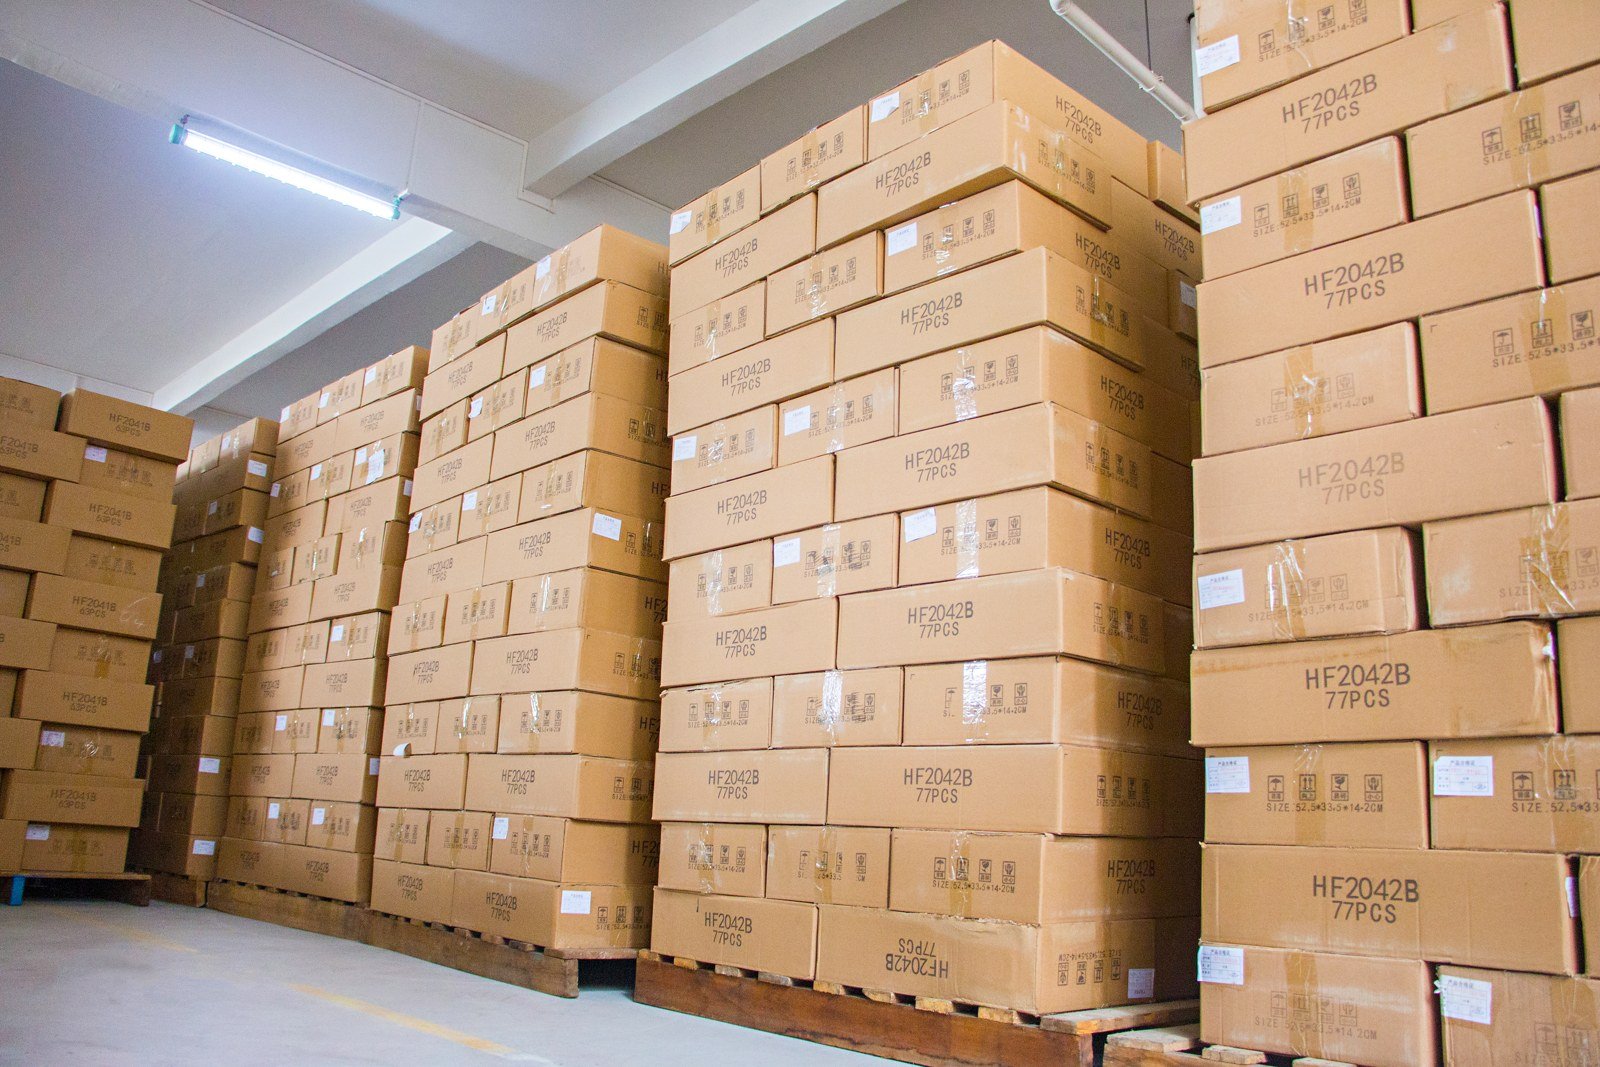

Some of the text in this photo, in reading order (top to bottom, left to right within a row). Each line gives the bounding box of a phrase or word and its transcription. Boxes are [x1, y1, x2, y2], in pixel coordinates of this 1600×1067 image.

[1282, 73, 1378, 123] HF2042B
[1056, 95, 1102, 137] HF2042B
[1301, 105, 1360, 134] 77PCS
[1065, 116, 1094, 145] 77PCS
[876, 151, 932, 190] HF2042B
[886, 173, 919, 198] 77PCS
[1155, 219, 1195, 254] HF2042B
[715, 238, 758, 271] HF2042B
[1075, 232, 1120, 271] HF2042B
[1163, 238, 1188, 262] 77PCS
[723, 258, 749, 278] 77PCS
[1084, 253, 1112, 279] 77PCS
[1304, 252, 1405, 296] HF2042B
[1324, 279, 1386, 309] 77PCS
[901, 292, 963, 325] HF2042B
[537, 311, 568, 336] HF2042B
[912, 313, 949, 335] 77PCS
[541, 326, 559, 343] 77PCS
[448, 361, 473, 383] HF2042B
[721, 358, 771, 387] HF2042B
[730, 377, 761, 396] 77PCS
[1101, 375, 1144, 410] HF2042B
[1108, 395, 1136, 421] 77PCS
[109, 413, 150, 432] HF2041B
[115, 424, 141, 437] 63PCS
[525, 421, 556, 441] HF2042B
[0, 435, 39, 452] F2041B
[529, 433, 548, 450] 77PCS
[905, 442, 970, 470] HF2042B
[437, 458, 463, 476] HF2042B
[917, 462, 957, 483] 77PCS
[1299, 451, 1405, 488] HF2042B
[440, 470, 457, 485] 77PCS
[718, 489, 767, 515] HF2042B
[1322, 479, 1385, 505] 77PCS
[89, 503, 132, 520] HF2041B
[726, 508, 757, 525] 77PCS
[518, 531, 551, 549] HF2042B
[1105, 528, 1150, 557] HF2042B
[523, 546, 544, 560] 77PCS
[1114, 548, 1142, 570] 77PCS
[427, 557, 454, 575] HF2042B
[72, 595, 117, 612] HF2041B
[908, 600, 974, 624] HF2042B
[715, 625, 767, 647] HF2042B
[920, 621, 959, 639] 77PCS
[506, 648, 538, 664] HF2042B
[725, 643, 756, 659] 77PCS
[414, 660, 440, 676] HF2042B
[511, 663, 531, 675] 77PCS
[1305, 662, 1411, 690] HF2042B
[417, 673, 433, 685] 77PCS
[63, 691, 108, 706] HF2041B
[1117, 691, 1162, 715] HF2042B
[1326, 688, 1390, 709] 77PCS
[1126, 711, 1153, 730] 77PCS
[404, 769, 431, 782] HF2042B
[502, 769, 535, 783] HF2042B
[708, 769, 760, 786] HF2042B
[904, 767, 973, 787] HF2042B
[51, 790, 97, 802] HF2041B
[408, 781, 424, 793] 77PCS
[506, 783, 527, 795] 77PCS
[717, 785, 748, 800] 77PCS
[916, 787, 958, 804] 77PCS
[1107, 859, 1155, 878] HF2042B
[398, 875, 423, 891] HF2042B
[1116, 879, 1146, 894] 77PCS
[1313, 875, 1419, 902] HF2042B
[401, 888, 417, 901] 77PCS
[486, 891, 517, 910] HF2042B
[491, 908, 511, 922] 77PCS
[1332, 900, 1396, 924] 77PCS
[704, 911, 753, 934] HF2042B
[712, 930, 742, 947] 77PCS
[898, 937, 936, 958] 77PCS
[886, 953, 949, 979] HF2042B
